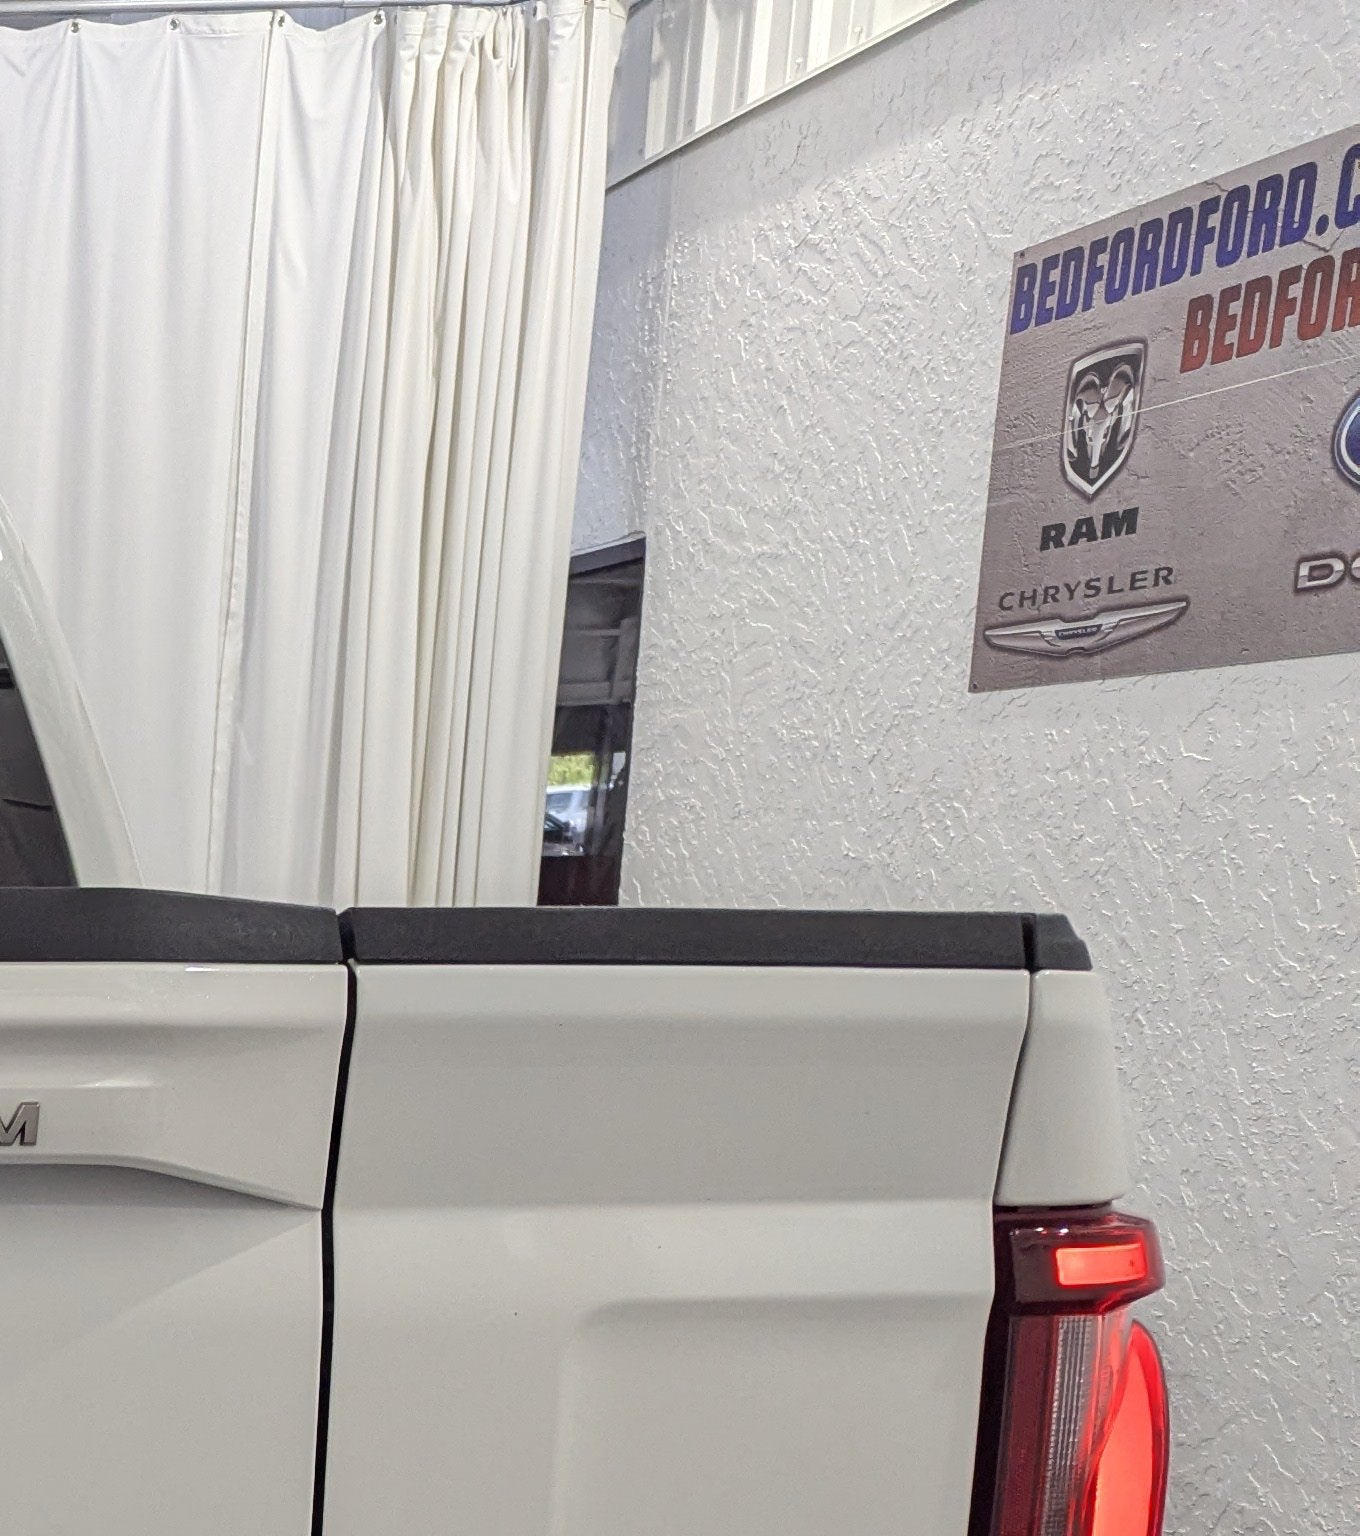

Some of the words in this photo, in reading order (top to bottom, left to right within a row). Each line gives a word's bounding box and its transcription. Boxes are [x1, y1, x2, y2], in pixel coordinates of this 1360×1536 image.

[1040, 507, 1139, 551] RAM
[998, 566, 1174, 611] CHRYSLER
[1296, 557, 1360, 589] D
